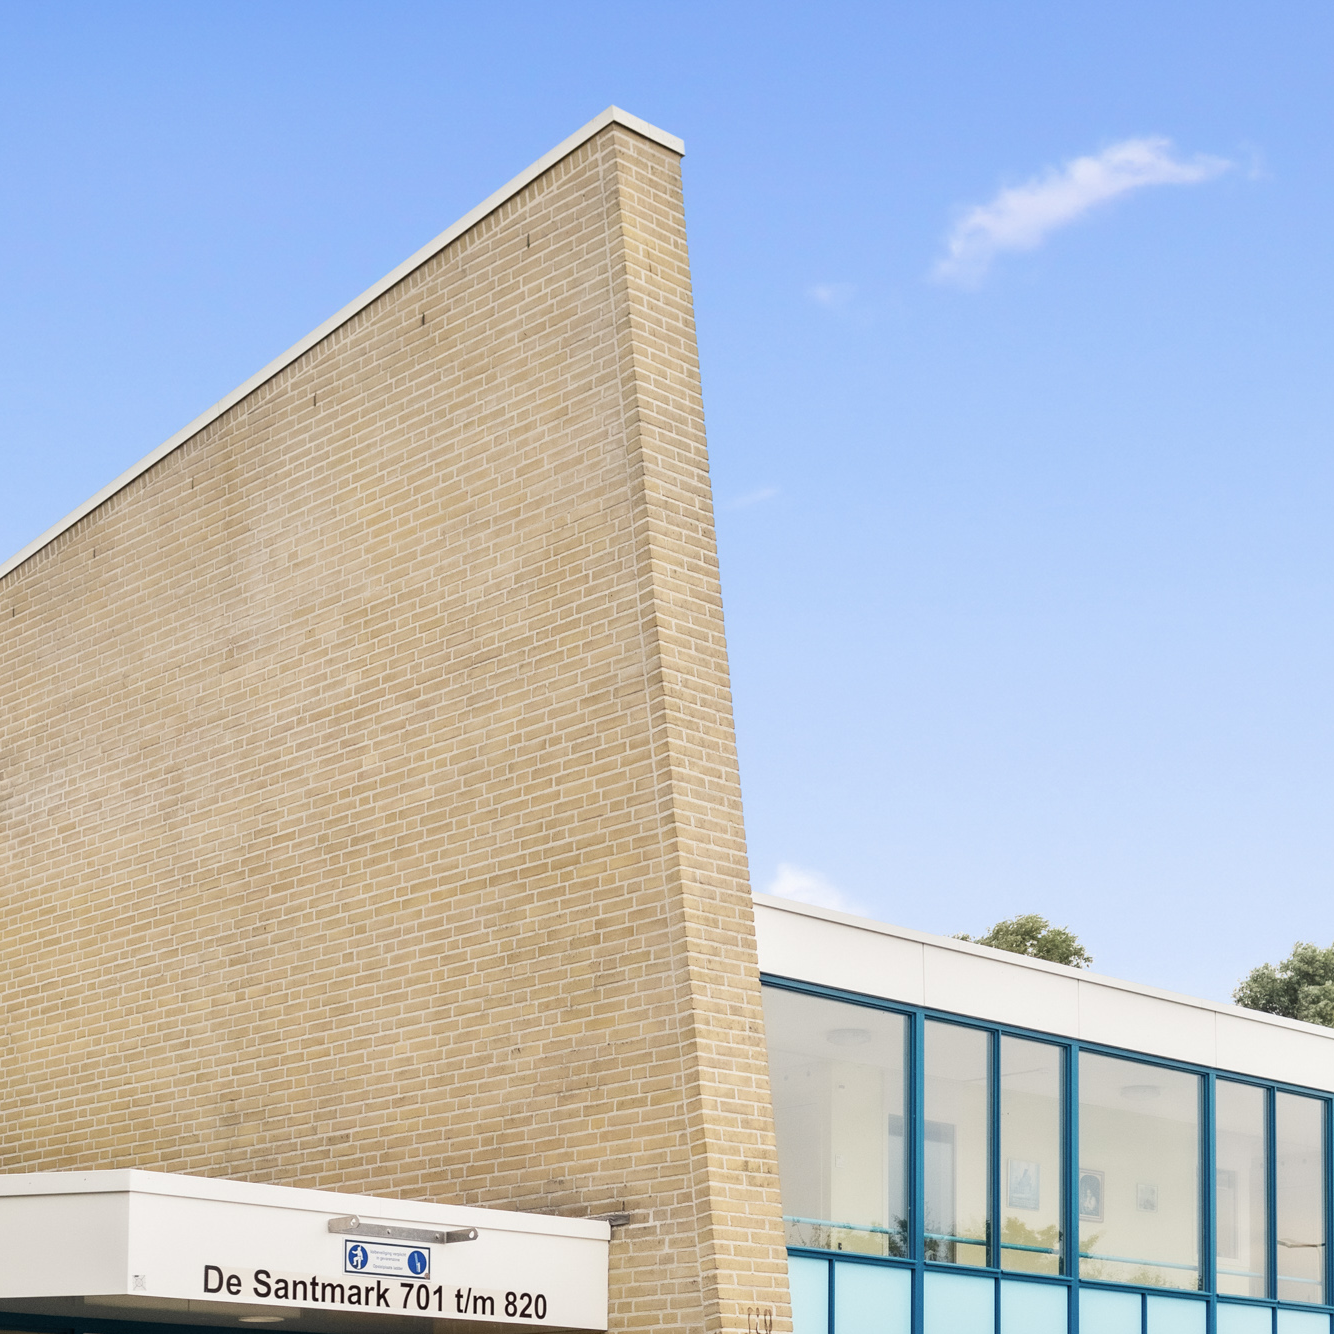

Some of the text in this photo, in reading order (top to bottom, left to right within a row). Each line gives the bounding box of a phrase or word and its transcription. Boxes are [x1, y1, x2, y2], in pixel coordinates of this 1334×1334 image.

[203, 1264, 547, 1320] De Santmark 701 t/m 820
